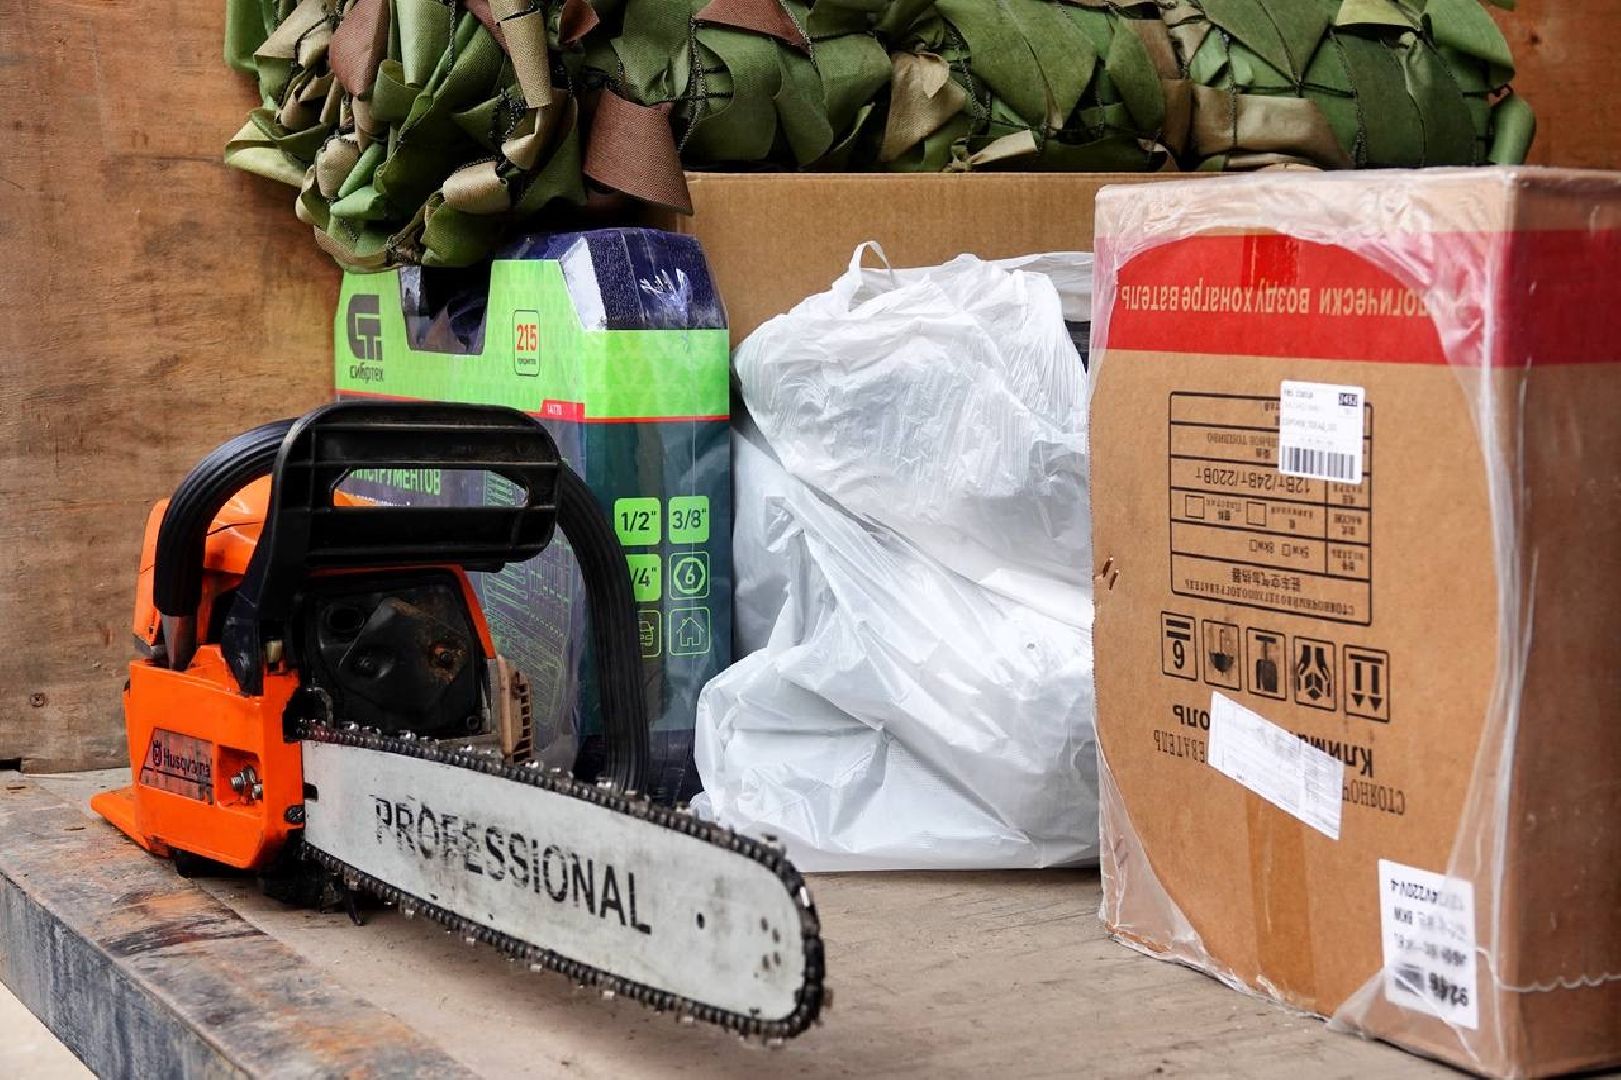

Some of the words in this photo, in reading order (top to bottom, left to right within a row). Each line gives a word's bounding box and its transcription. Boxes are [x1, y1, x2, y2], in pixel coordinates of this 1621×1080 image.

[1121, 277, 1309, 314] воздухонагреватель
[1319, 286, 1433, 316] логически
[516, 324, 537, 352] 215
[631, 567, 658, 587] /4"
[685, 565, 696, 584] 6
[1172, 639, 1186, 669] 6
[1343, 779, 1406, 816] СТОЯНОЧ
[375, 796, 652, 936] PROFESSIONAL
